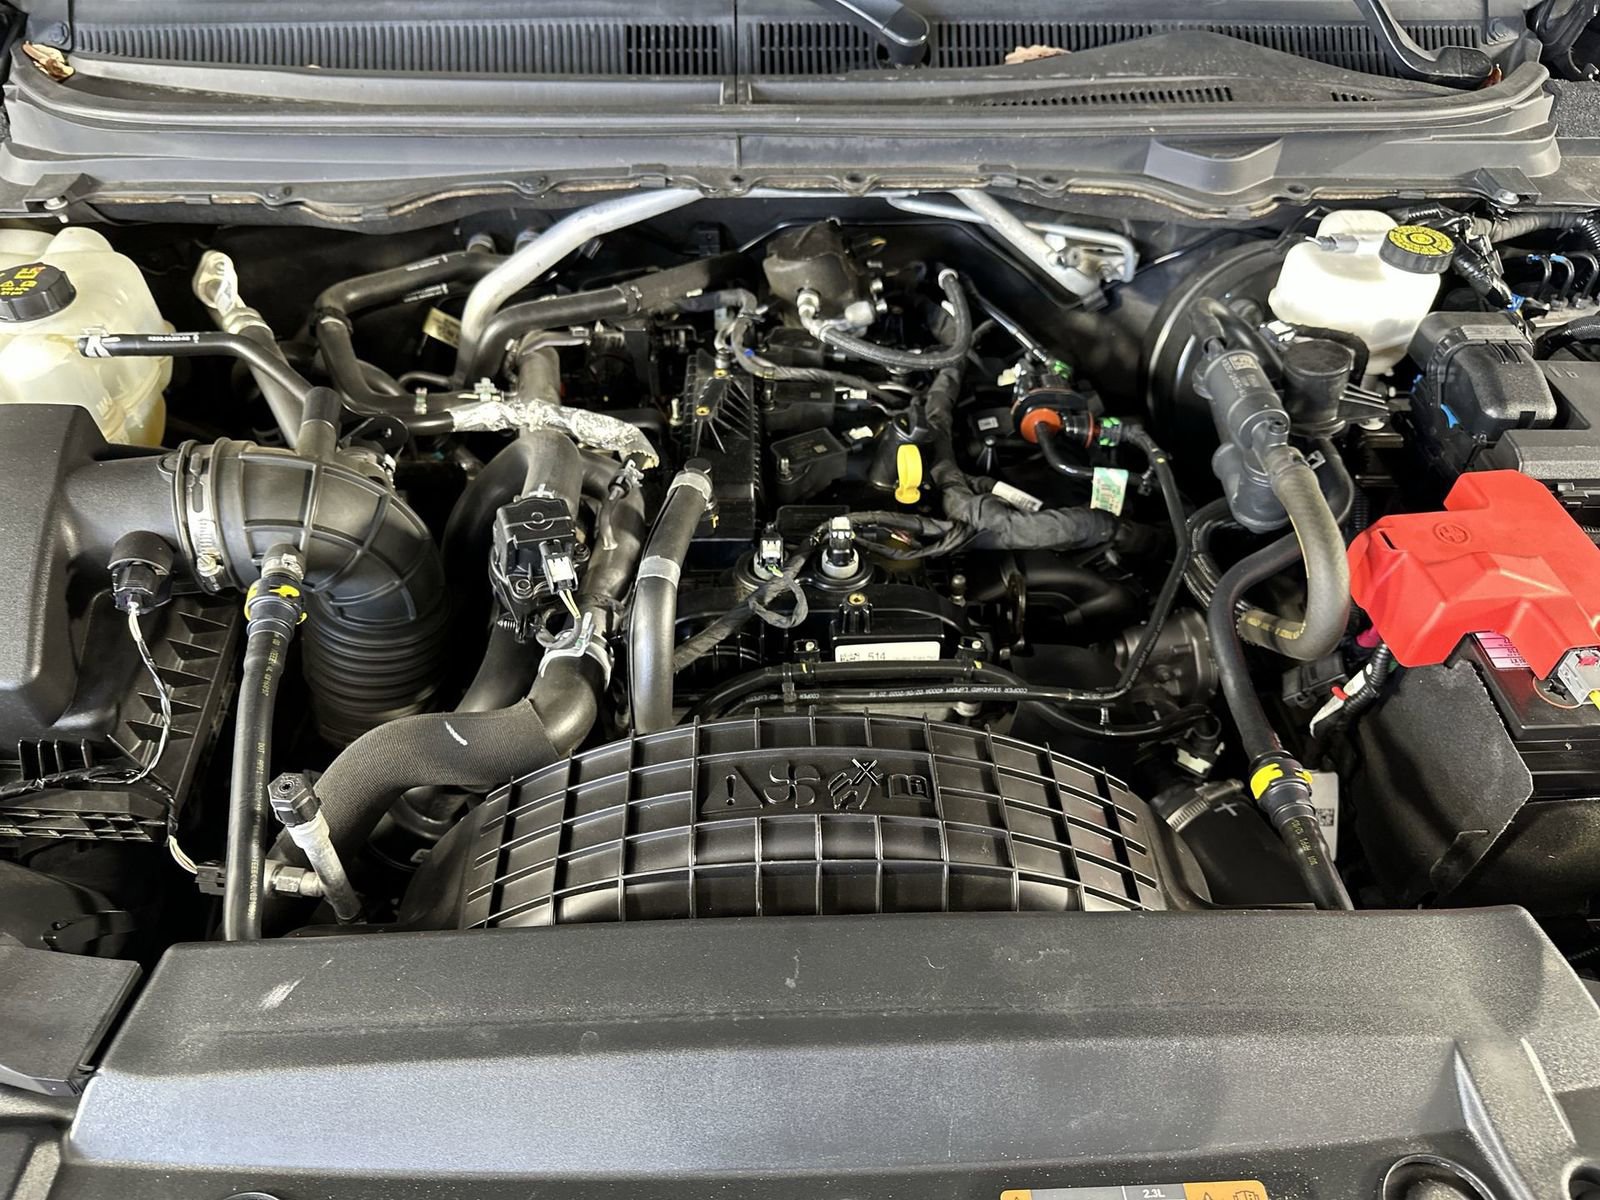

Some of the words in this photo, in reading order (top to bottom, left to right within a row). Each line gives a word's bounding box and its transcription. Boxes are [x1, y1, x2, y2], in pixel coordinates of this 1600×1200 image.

[970, 686, 1002, 694] STANDARD
[257, 742, 266, 755] DOT
[1142, 1188, 1166, 1199] 2.3L
